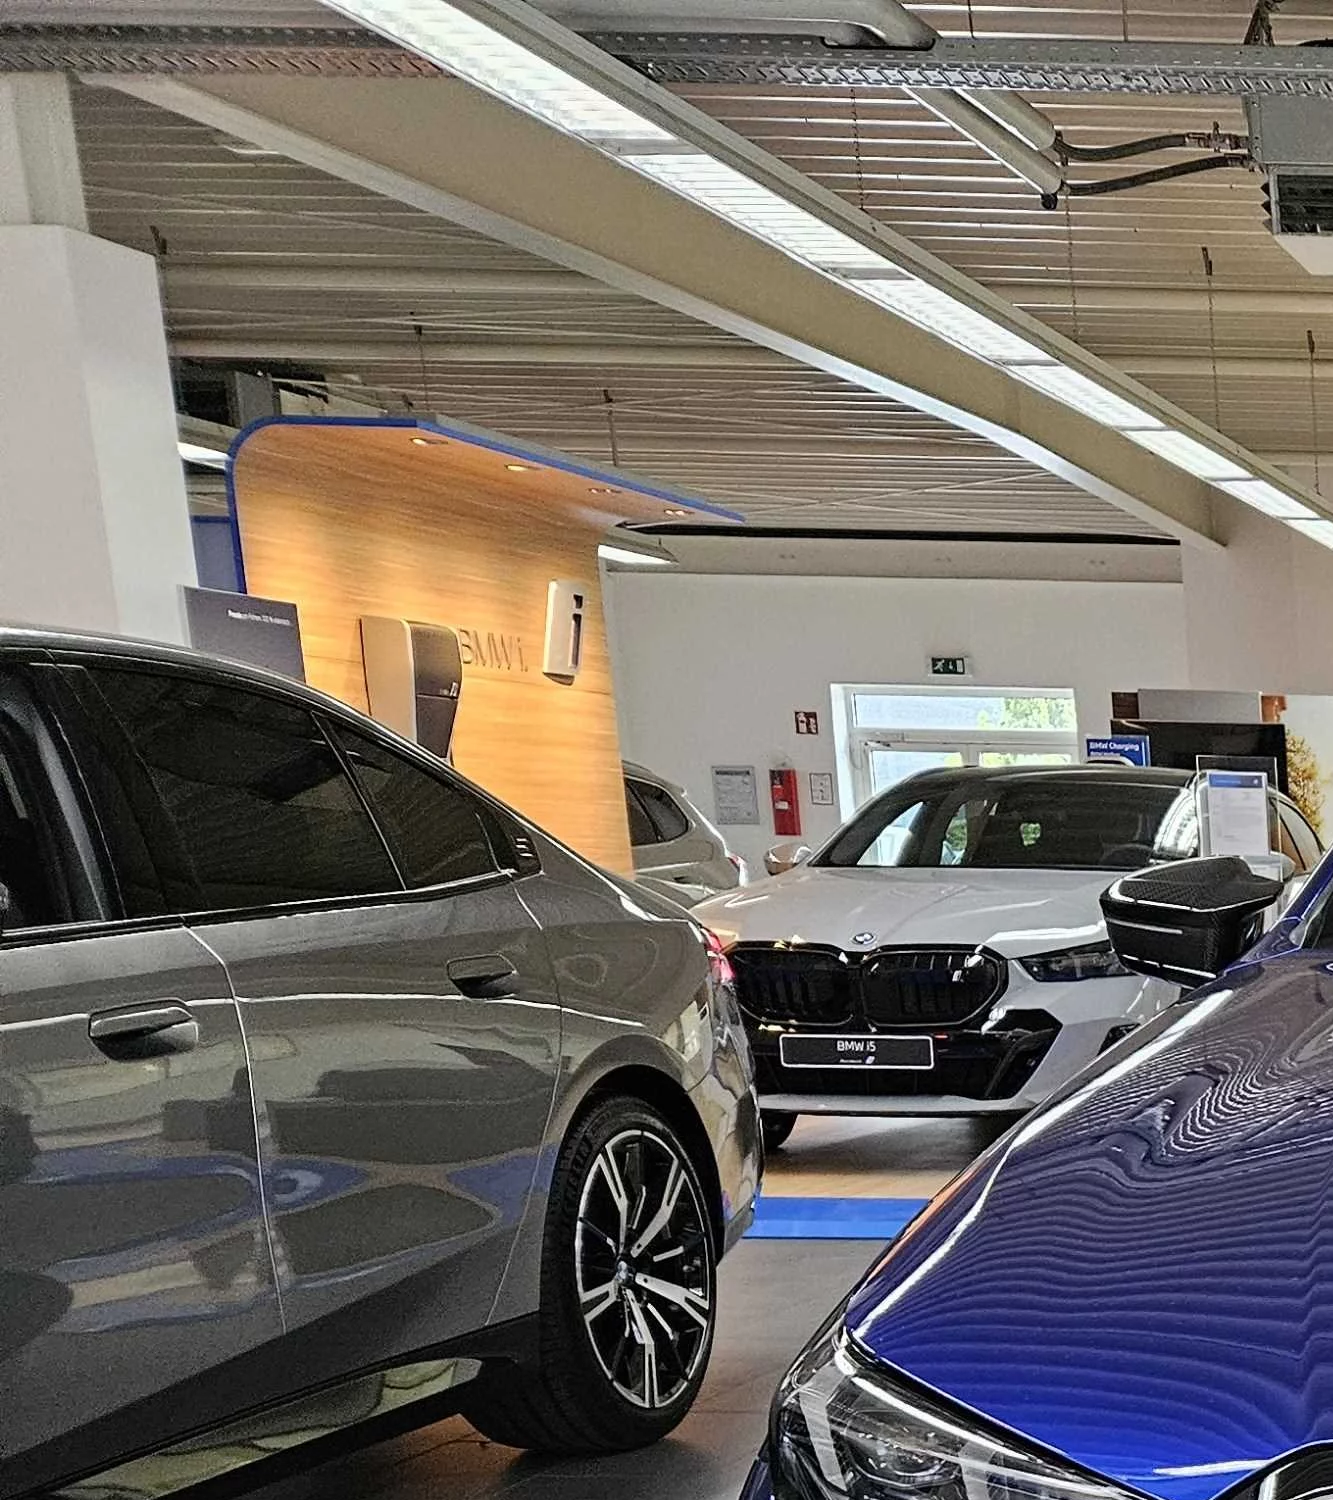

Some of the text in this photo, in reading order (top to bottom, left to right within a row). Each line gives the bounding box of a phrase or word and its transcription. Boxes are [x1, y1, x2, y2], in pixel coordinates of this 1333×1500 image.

[459, 628, 513, 670] BMW
[1109, 741, 1140, 751] Charging
[837, 1040, 877, 1052] BMW i5
